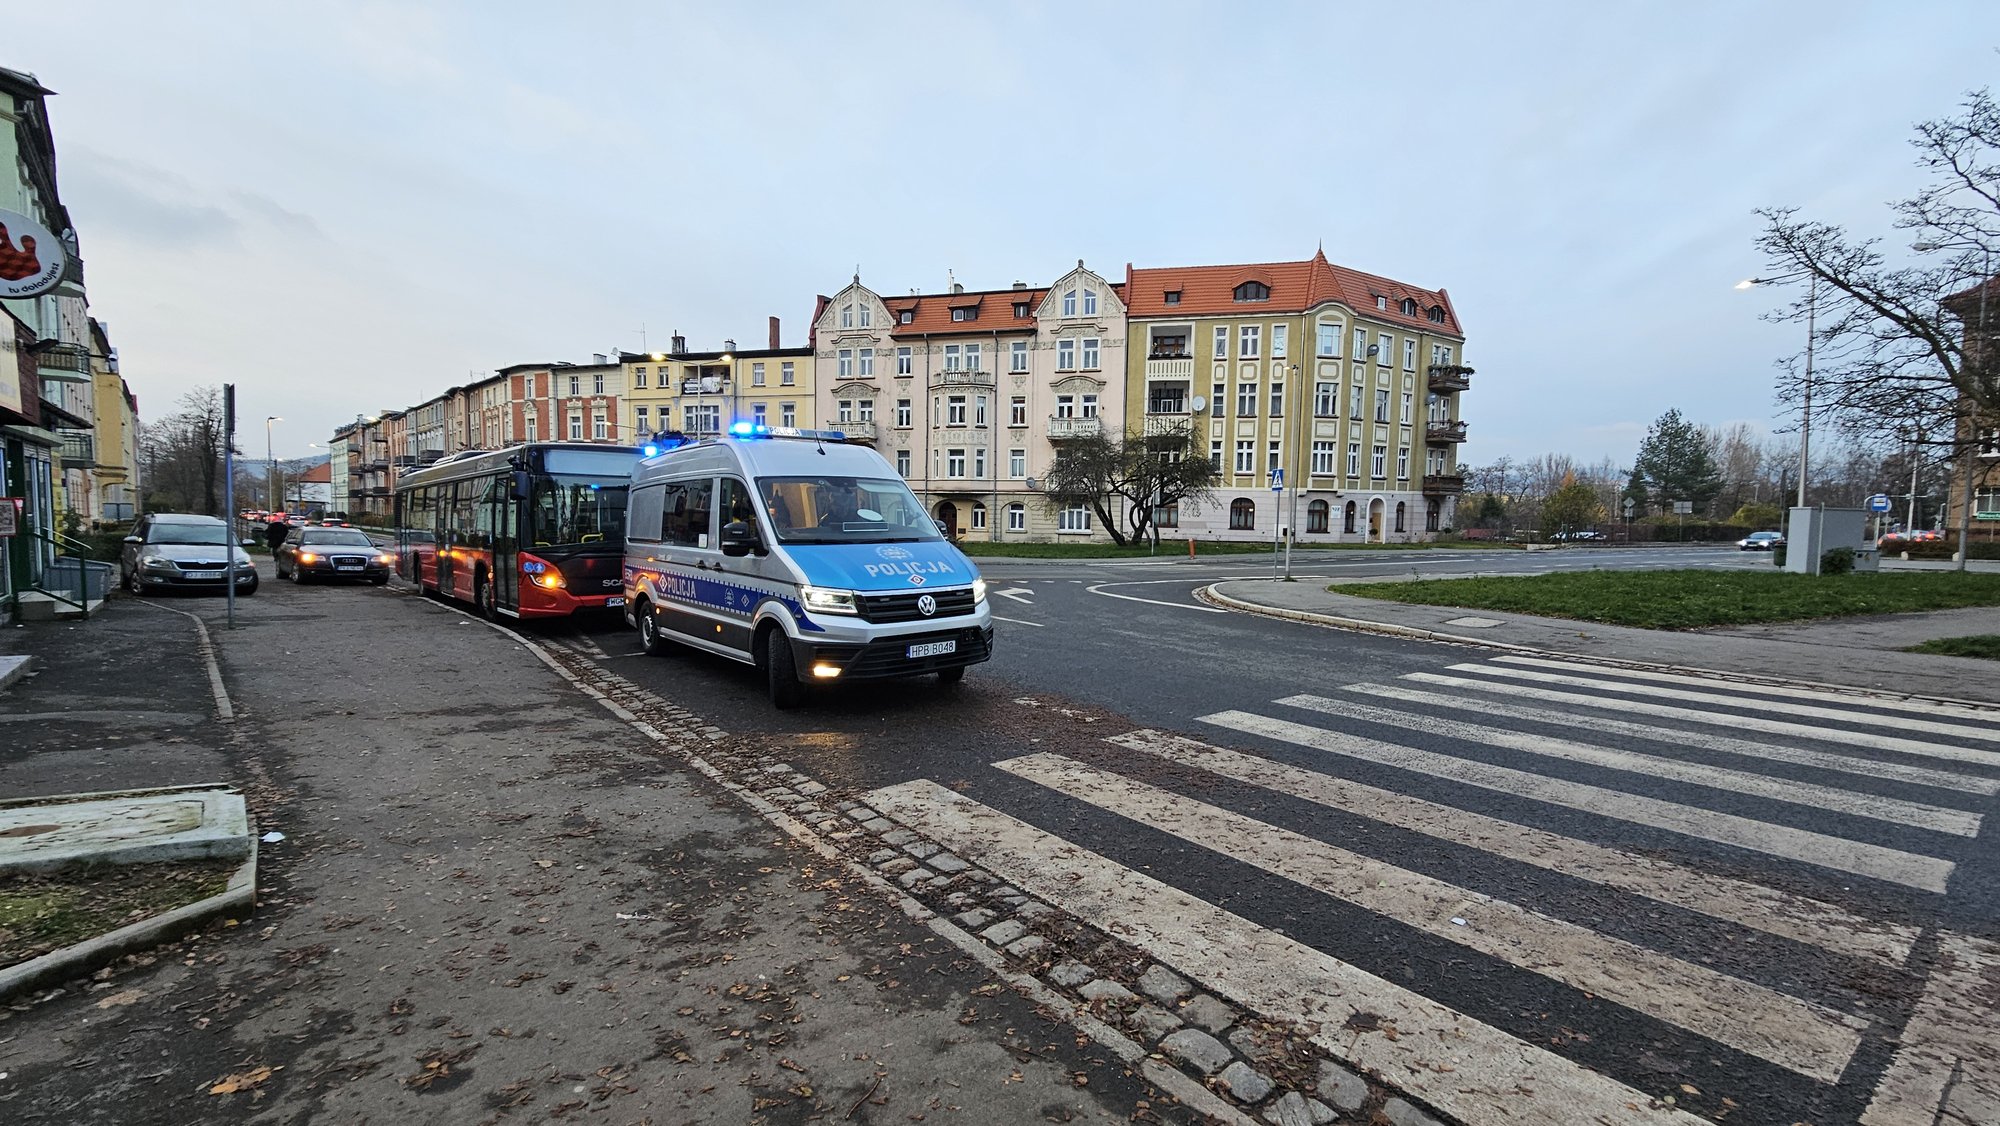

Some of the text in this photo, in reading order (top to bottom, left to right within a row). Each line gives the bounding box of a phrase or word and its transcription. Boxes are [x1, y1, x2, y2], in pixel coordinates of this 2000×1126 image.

[21, 262, 60, 293] doładujesz
[768, 426, 800, 436] POLICJA
[863, 560, 955, 578] POLICJA
[667, 577, 697, 599] POLICJA
[911, 641, 954, 657] HPB B048
